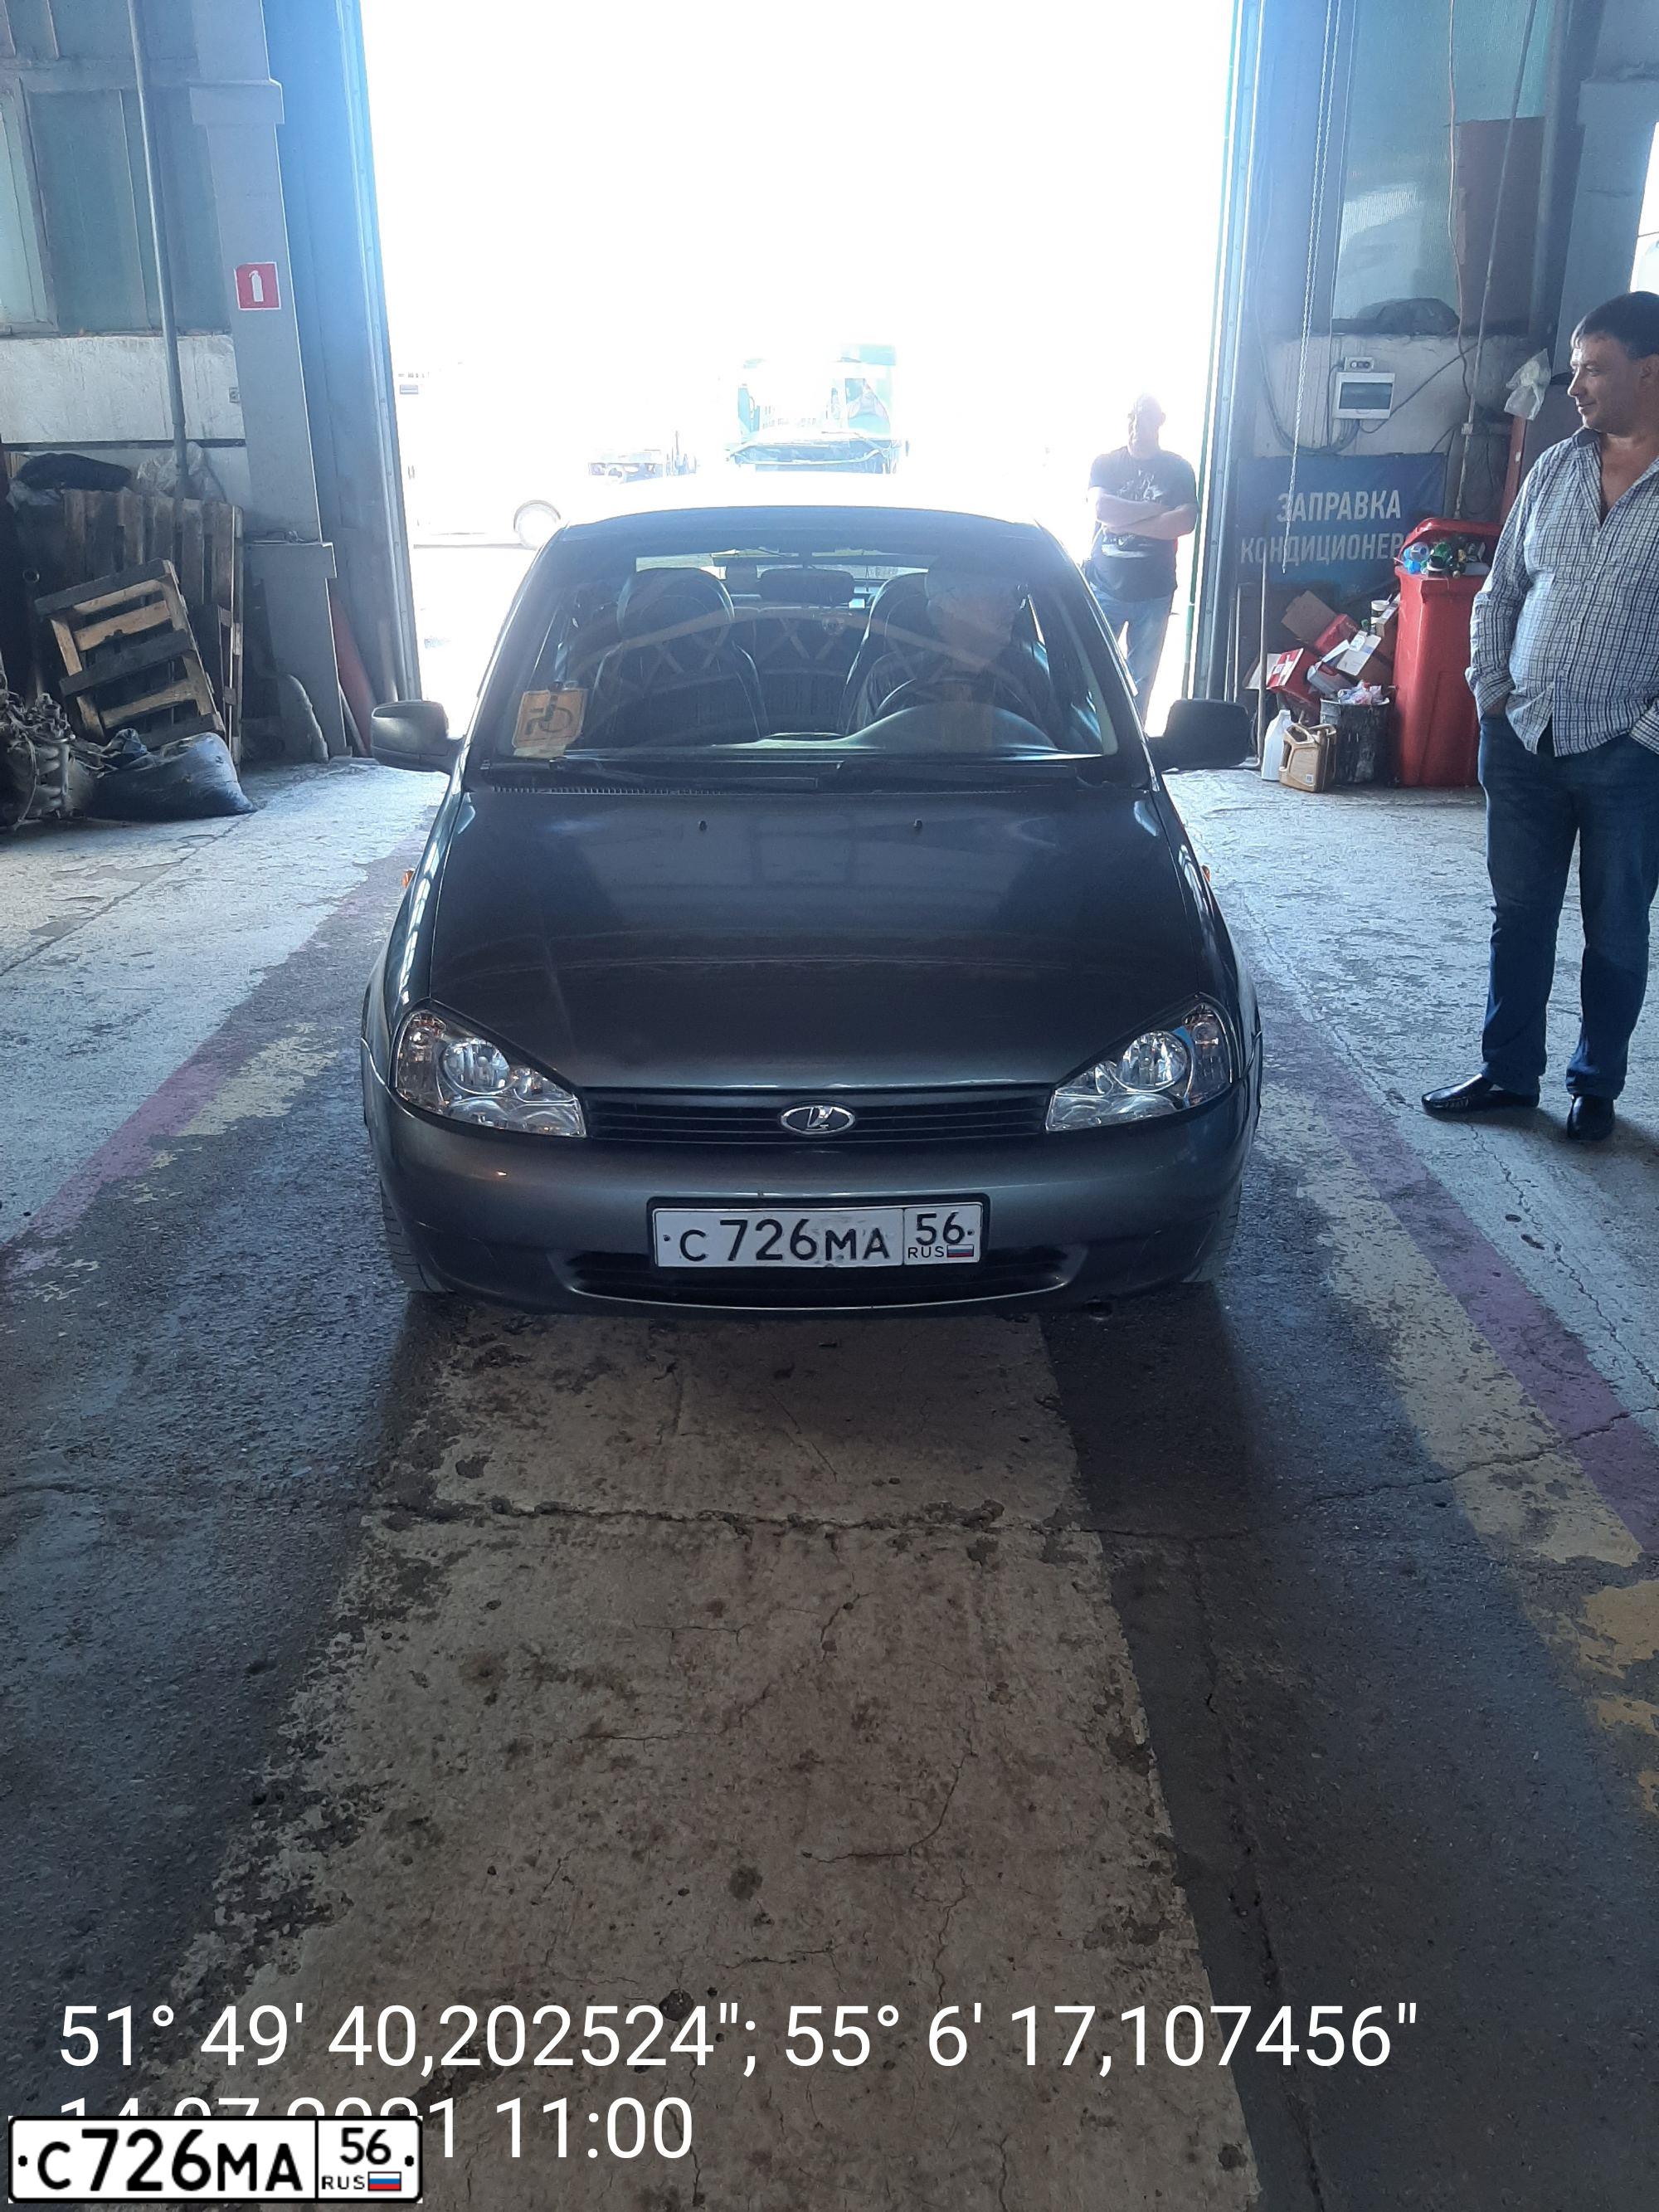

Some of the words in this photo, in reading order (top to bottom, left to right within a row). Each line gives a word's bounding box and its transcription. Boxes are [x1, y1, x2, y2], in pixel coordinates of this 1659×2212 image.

[1277, 490, 1401, 523] ЗАПРАВКА
[679, 1218, 890, 1262] С726МА
[915, 1211, 966, 1246] 56
[907, 1245, 945, 1259] RUS
